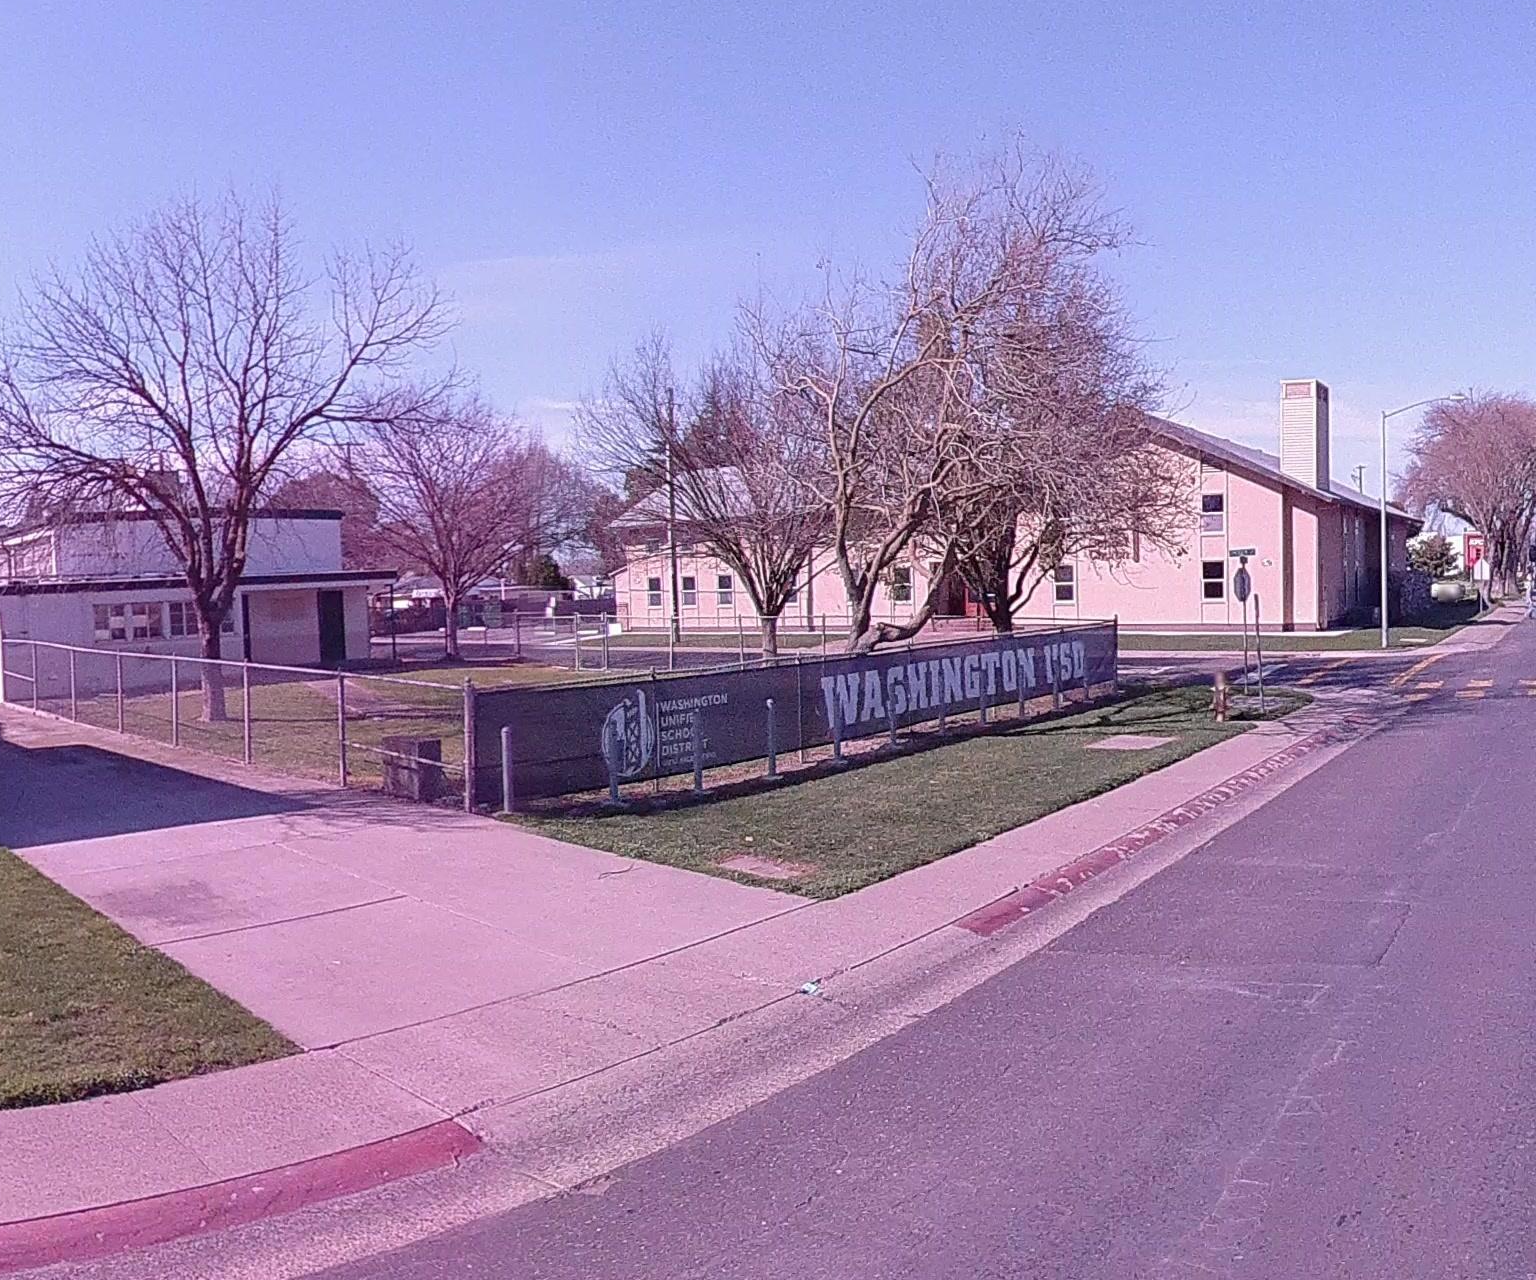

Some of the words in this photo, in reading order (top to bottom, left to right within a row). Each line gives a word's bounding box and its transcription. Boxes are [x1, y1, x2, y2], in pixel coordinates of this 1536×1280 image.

[820, 647, 1037, 729] WASHINGTON
[660, 693, 728, 712] WASHINGTON
[661, 712, 697, 727] UNIFIE
[661, 726, 704, 741] SCHO
[662, 737, 709, 756] DISTRIT
